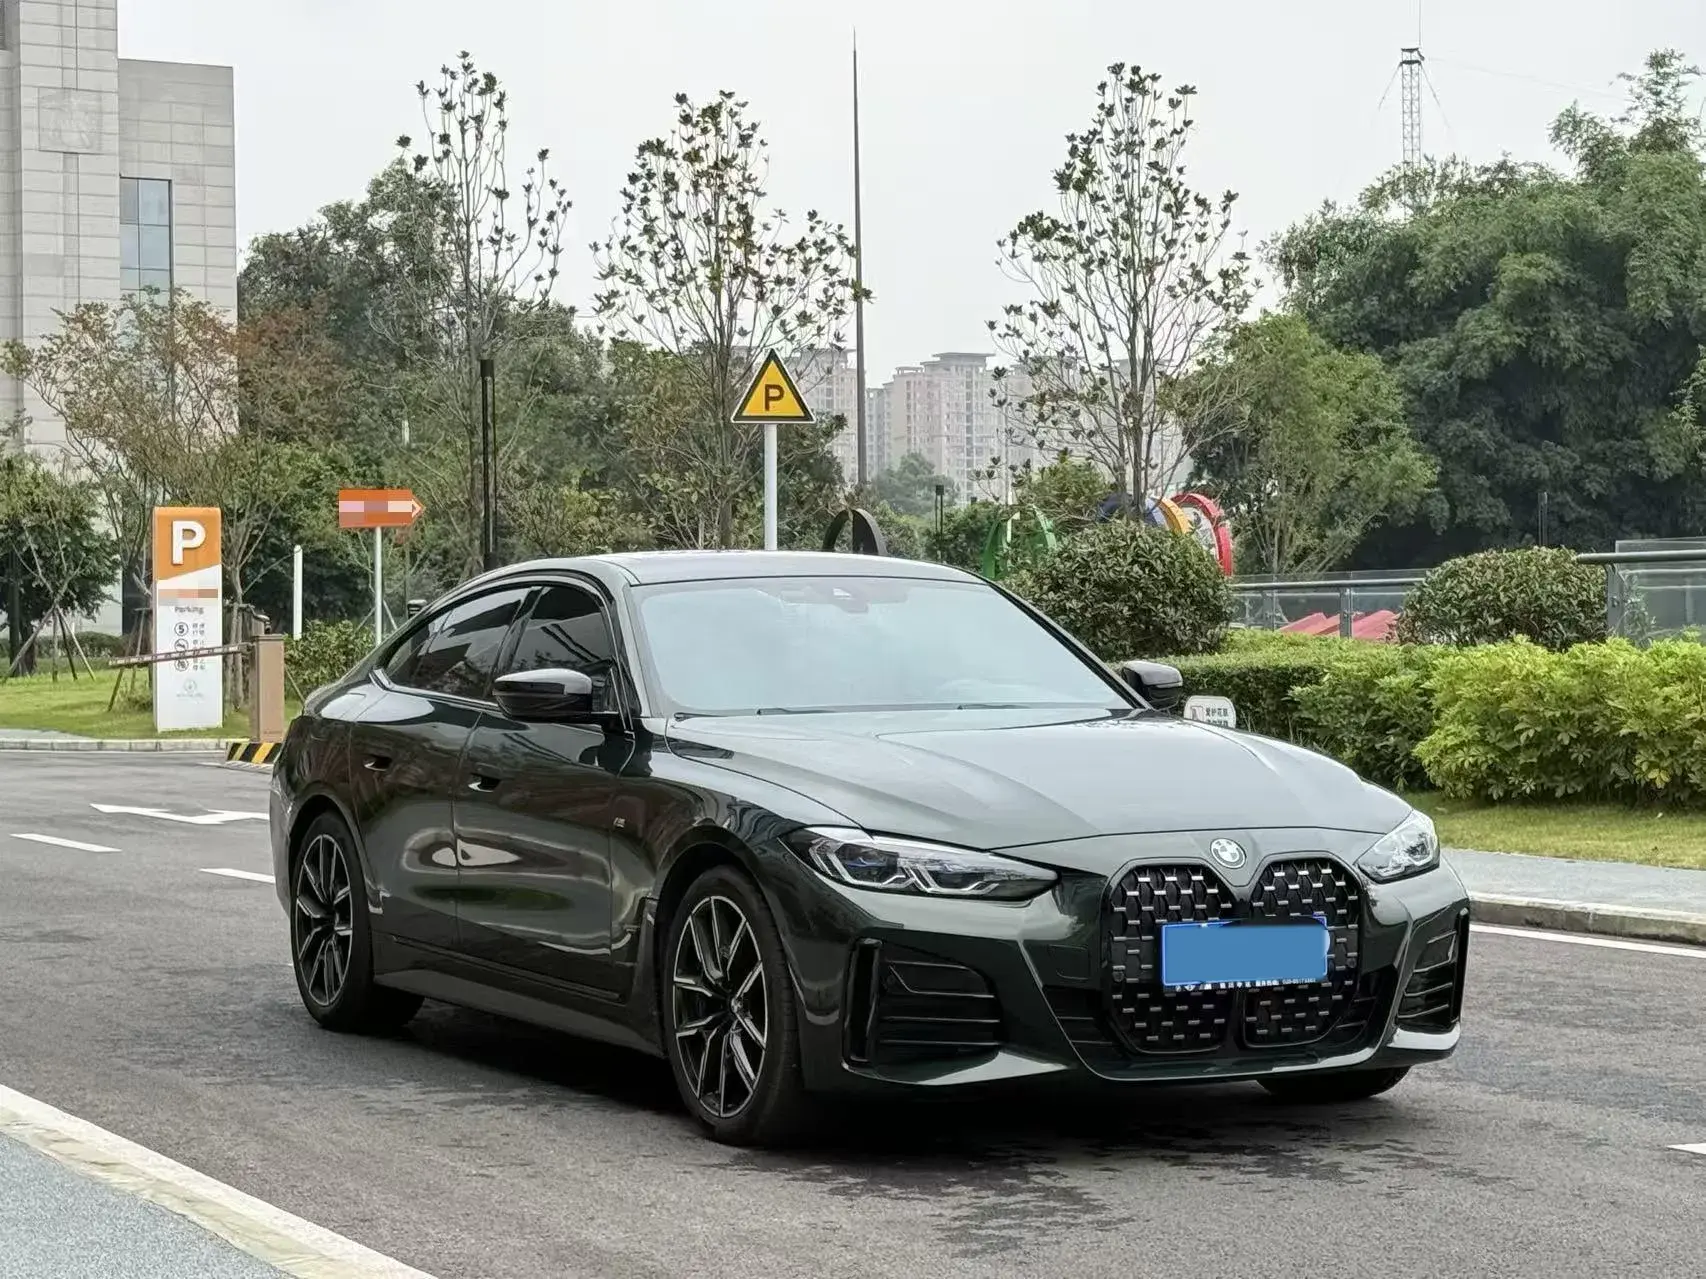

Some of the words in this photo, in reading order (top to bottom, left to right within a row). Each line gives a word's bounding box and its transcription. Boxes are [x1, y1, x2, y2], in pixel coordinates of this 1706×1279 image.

[764, 384, 785, 411] P
[172, 520, 206, 565] P
[174, 606, 204, 615] Parking
[178, 625, 185, 634] 5
